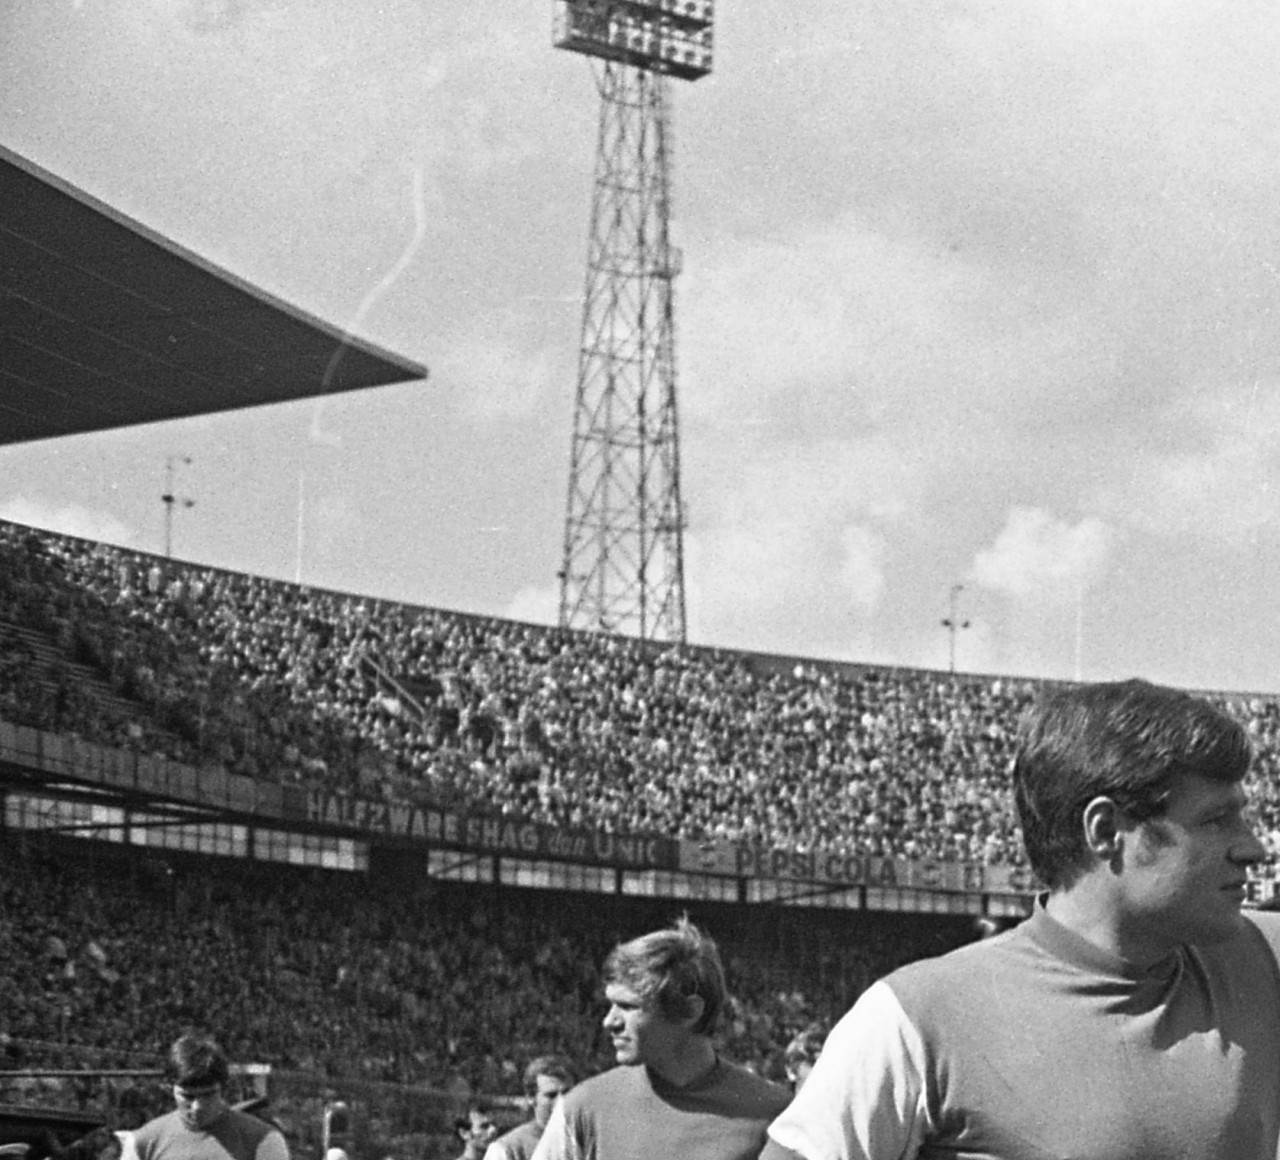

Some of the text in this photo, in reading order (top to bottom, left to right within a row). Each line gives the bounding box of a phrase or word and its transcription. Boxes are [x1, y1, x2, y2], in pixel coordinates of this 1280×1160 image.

[466, 817, 539, 851] SHAG
[736, 847, 897, 886] PEPSI COLA
